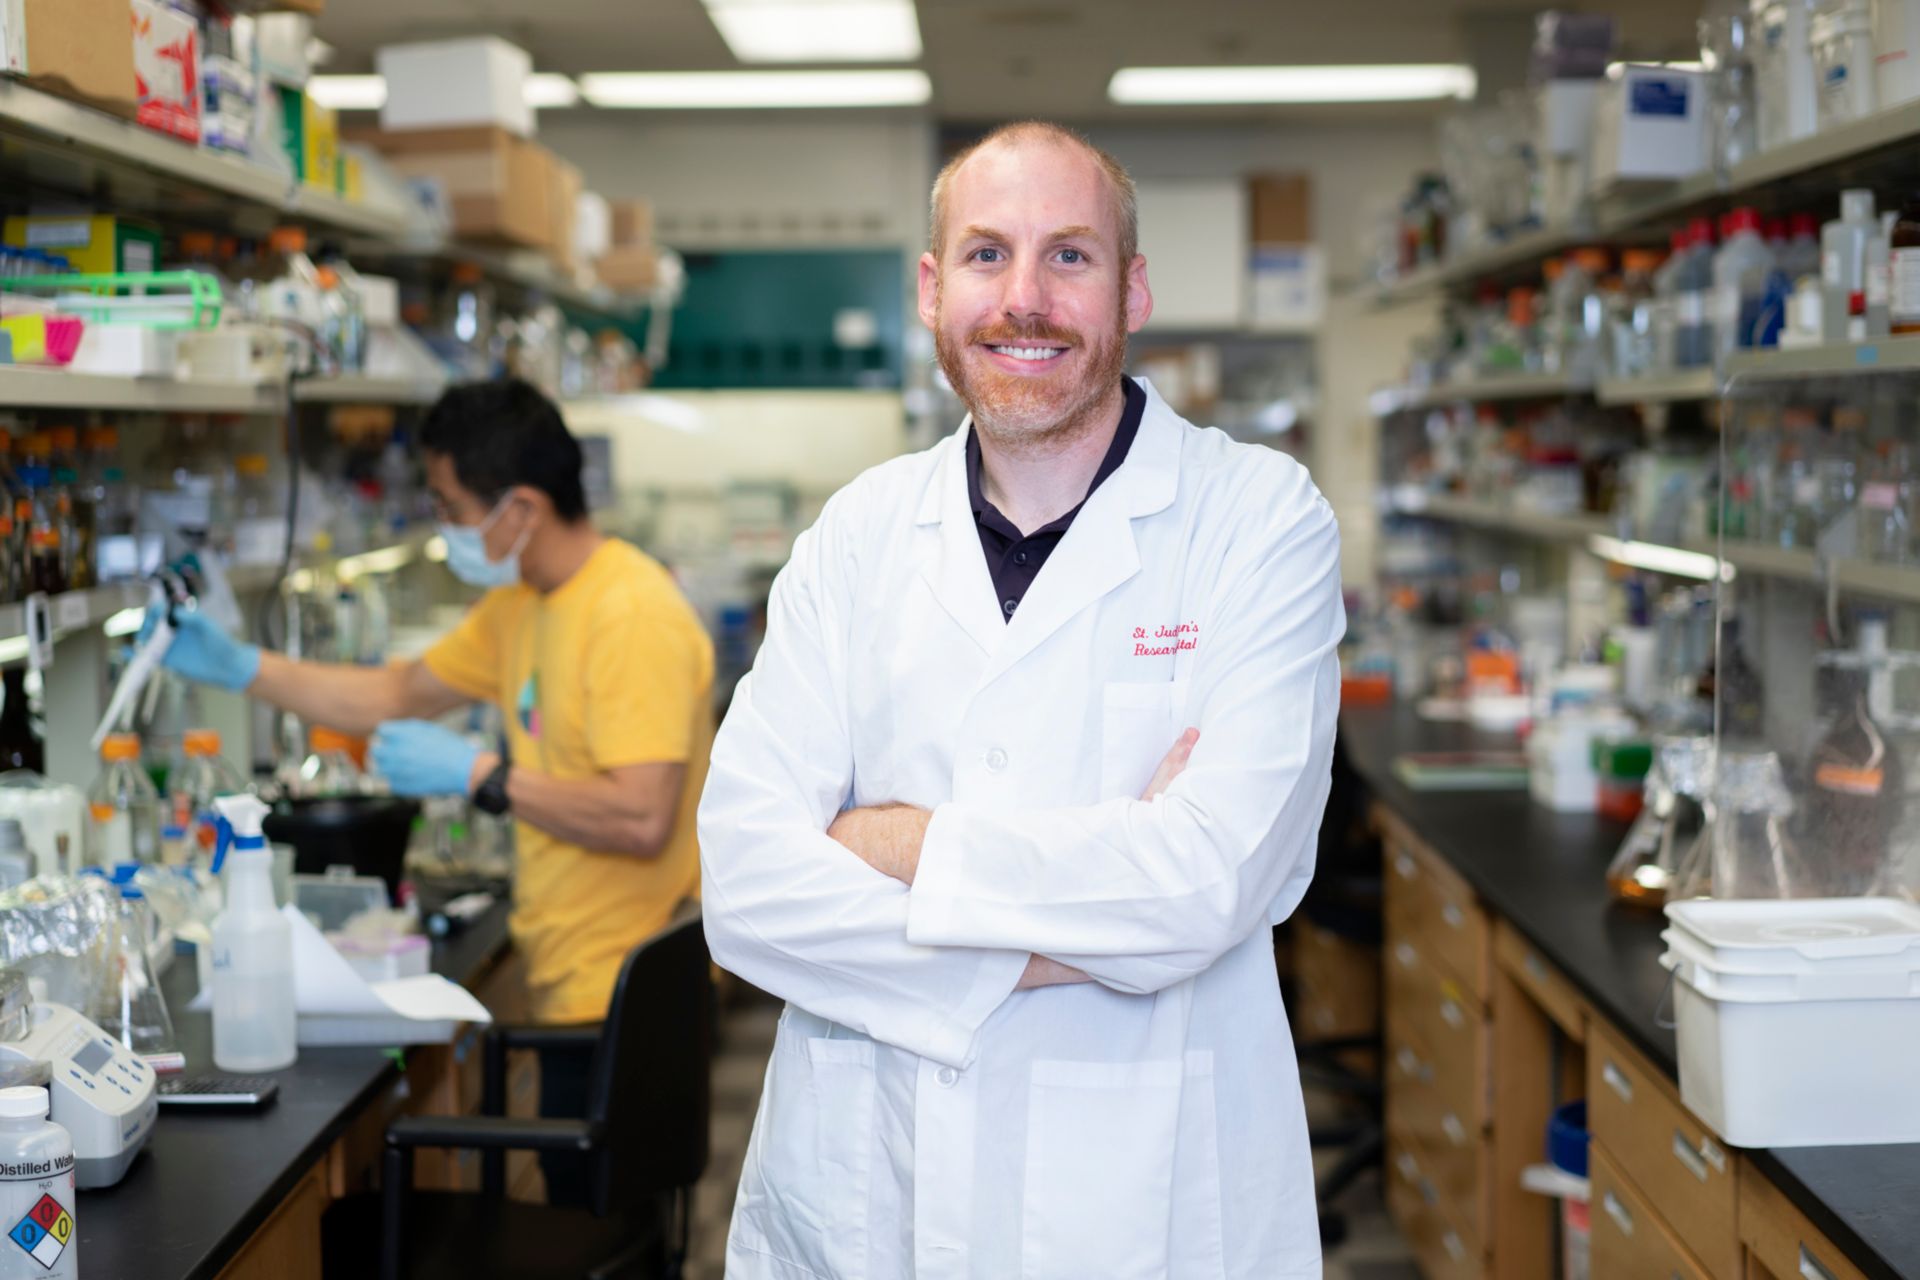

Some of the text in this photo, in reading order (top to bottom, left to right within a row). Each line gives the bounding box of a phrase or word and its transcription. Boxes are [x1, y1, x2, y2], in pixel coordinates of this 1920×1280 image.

[1132, 627, 1149, 639] St.
[1155, 624, 1179, 638] Jud
[1176, 637, 1198, 650] ital
[40, 1202, 54, 1222] 0
[21, 1223, 36, 1244] 0
[59, 1217, 68, 1237] 0
